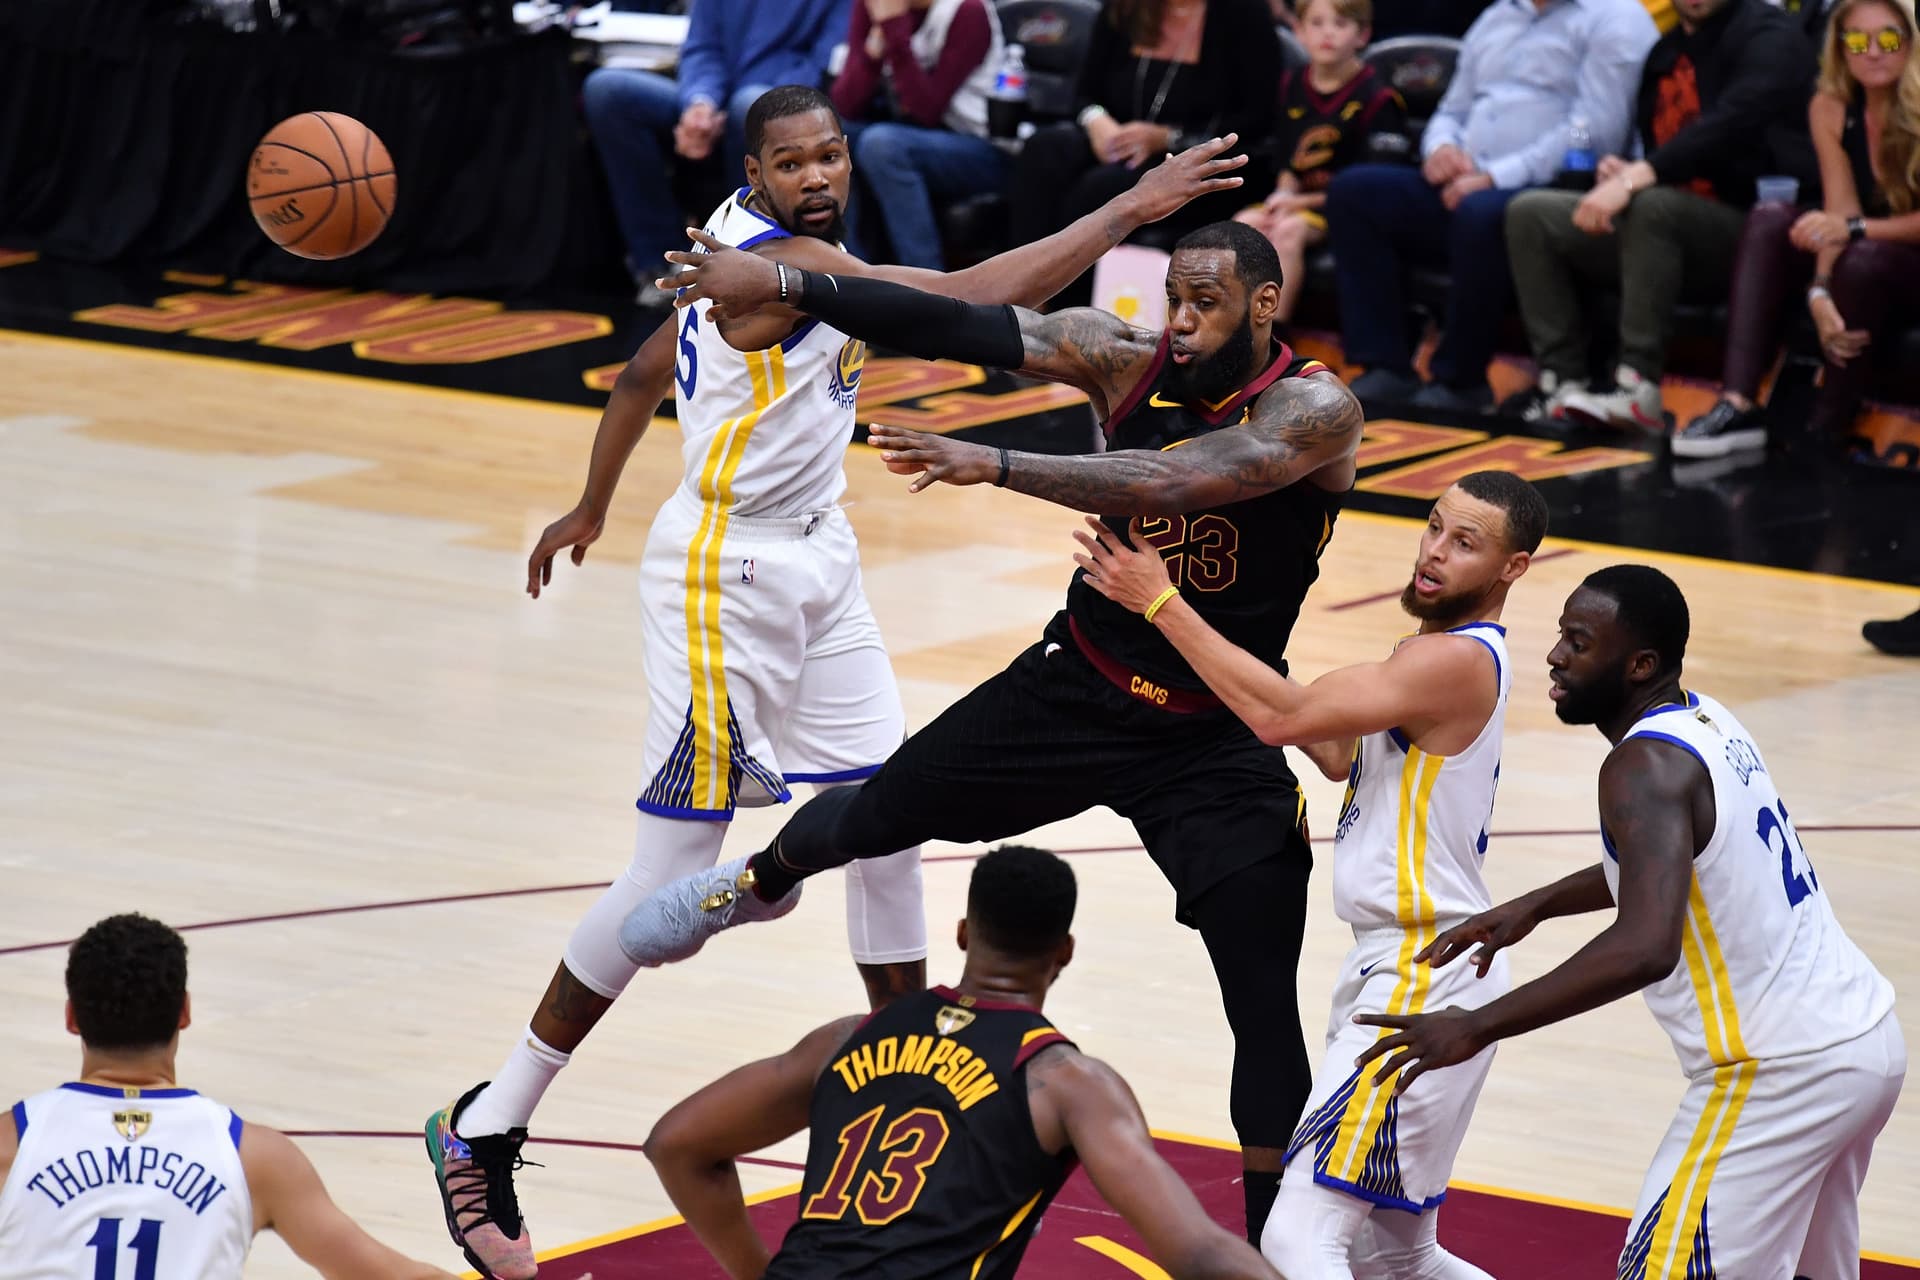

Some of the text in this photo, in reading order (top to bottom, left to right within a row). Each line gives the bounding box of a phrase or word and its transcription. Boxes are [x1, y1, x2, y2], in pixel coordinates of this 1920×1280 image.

[1143, 514, 1239, 592] 23
[1131, 675, 1169, 705] CAVS
[832, 1034, 999, 1112] THOMPSON
[26, 1146, 226, 1215] THOMPSON
[802, 1104, 950, 1225] 13
[86, 1217, 165, 1280] 11
